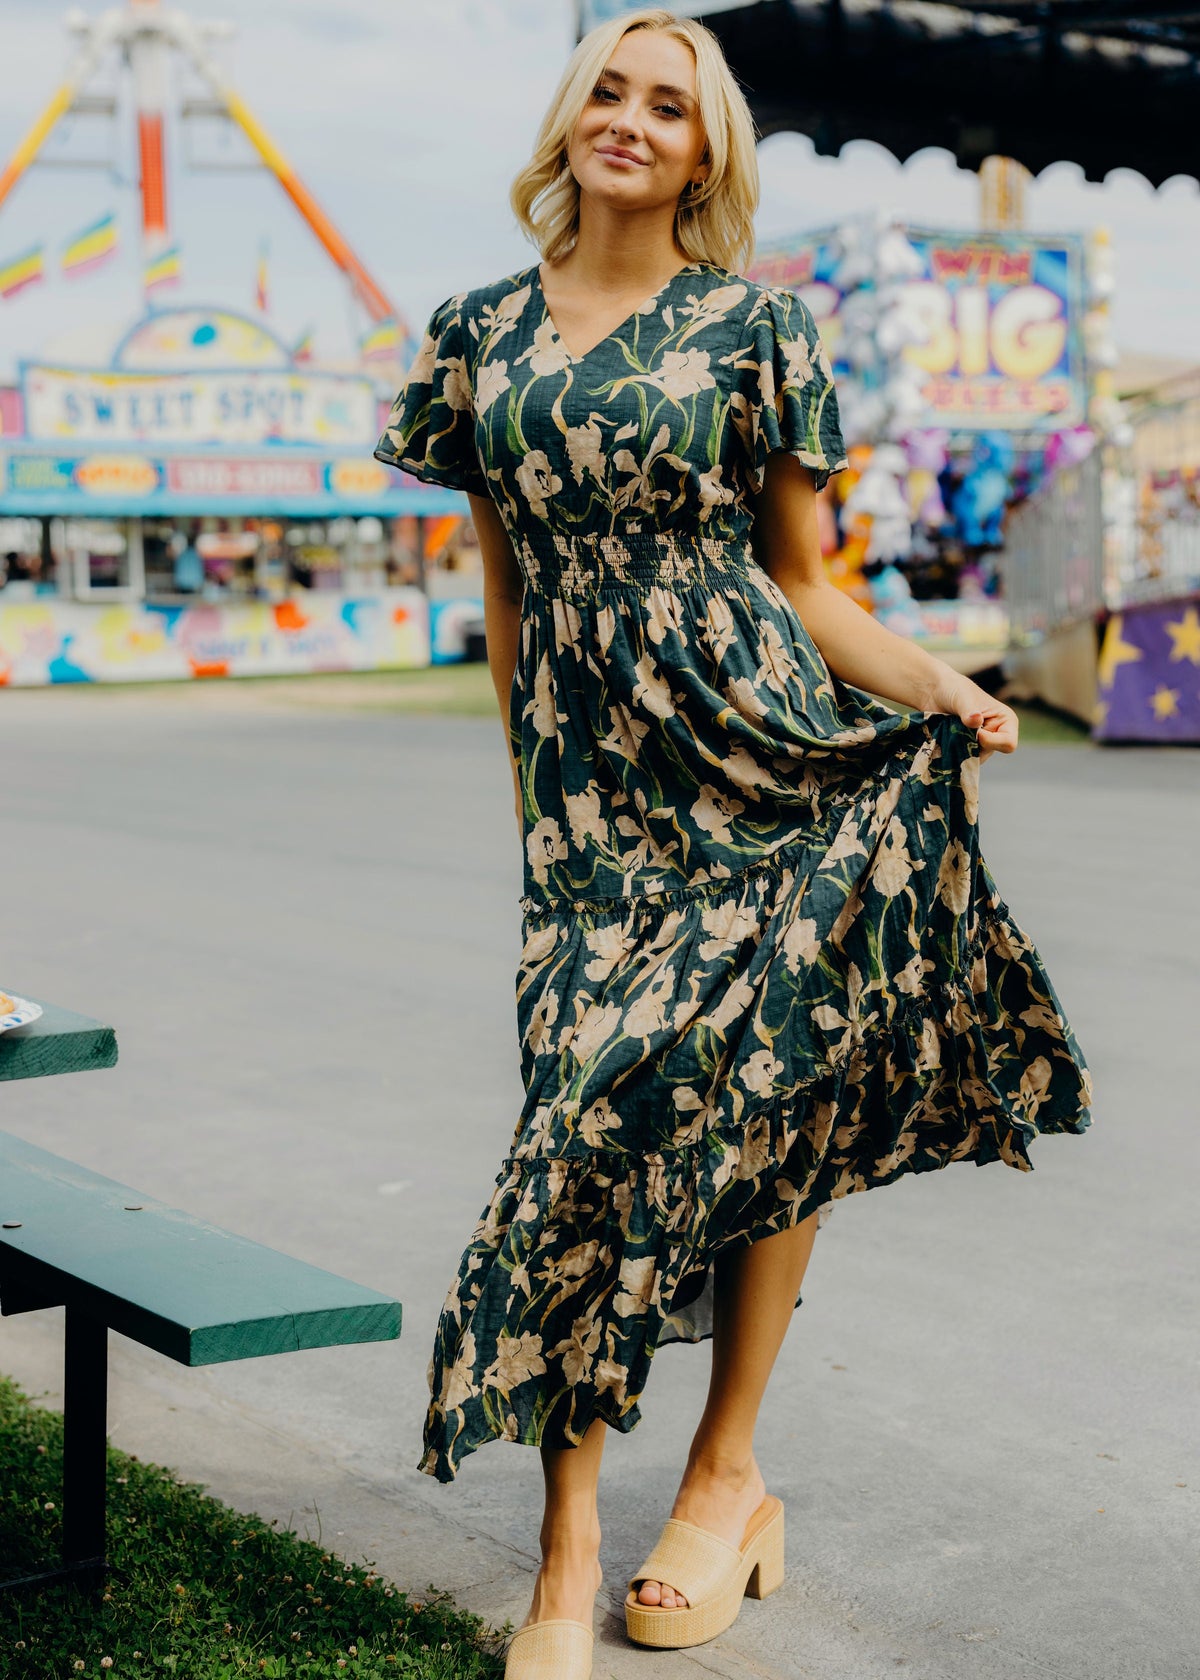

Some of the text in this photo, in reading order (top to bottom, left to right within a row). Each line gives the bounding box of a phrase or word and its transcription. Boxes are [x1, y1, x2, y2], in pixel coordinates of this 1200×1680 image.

[933, 247, 1031, 286] WIN
[63, 386, 306, 427] SWEET SPOT
